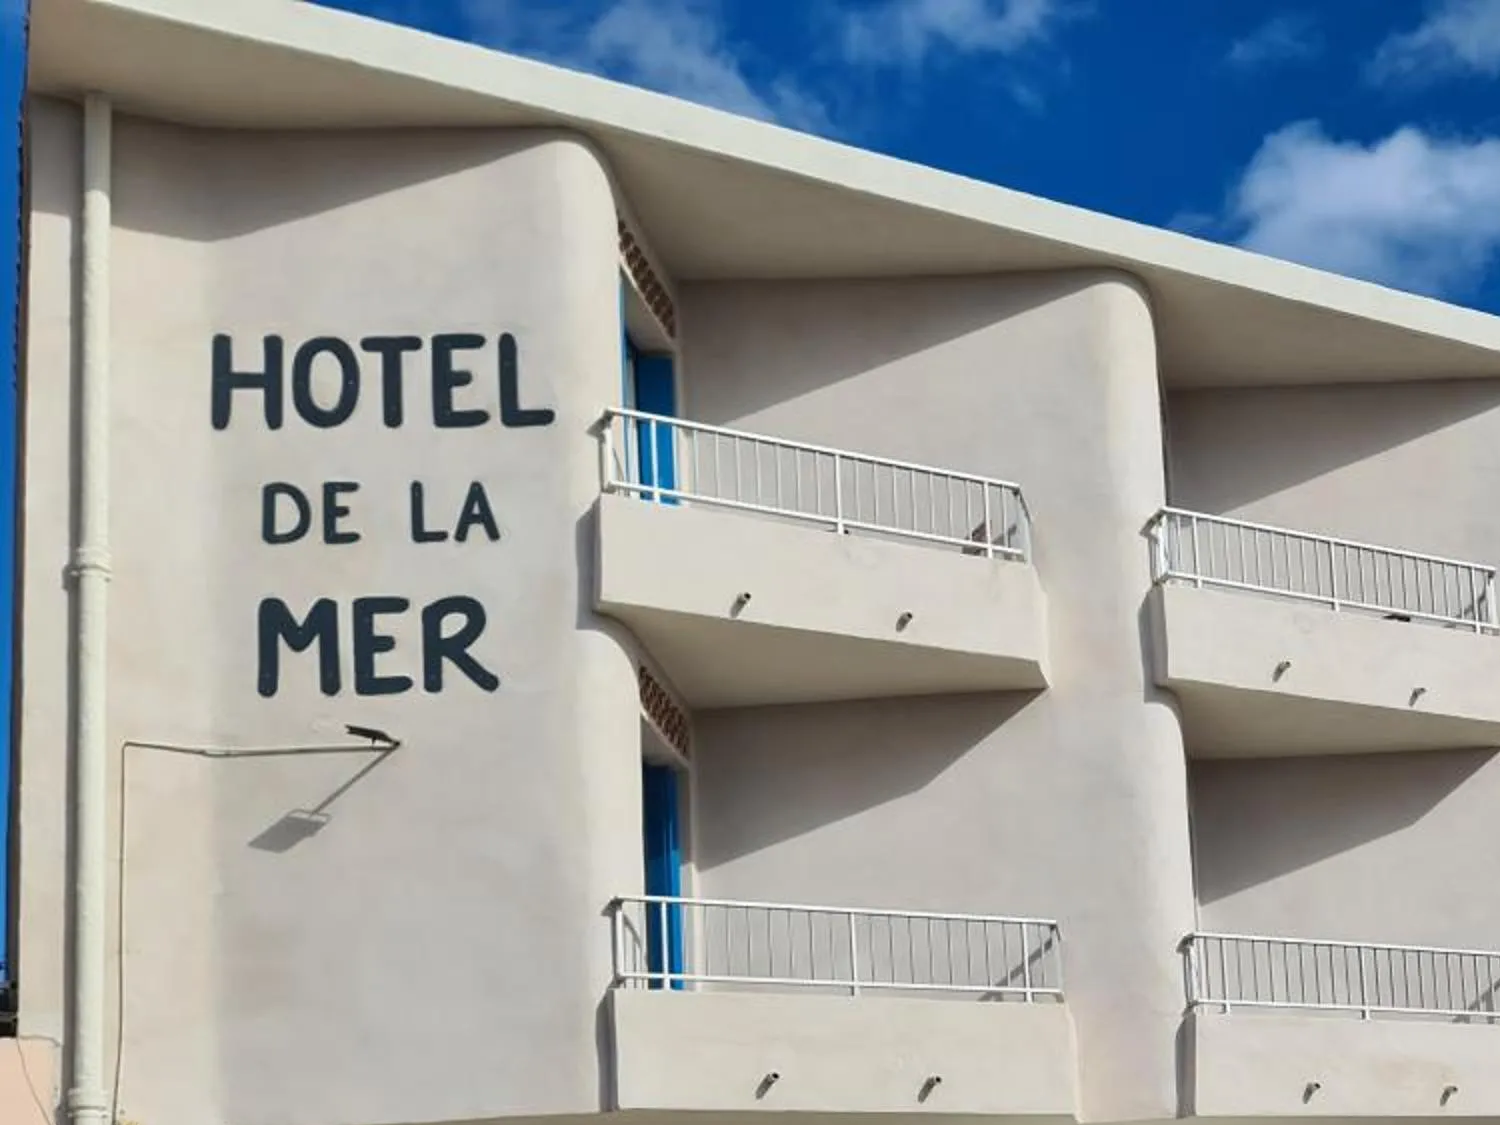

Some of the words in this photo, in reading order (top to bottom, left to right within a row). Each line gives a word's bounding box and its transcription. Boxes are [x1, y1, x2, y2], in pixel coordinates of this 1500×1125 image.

[211, 332, 555, 431] HOTEL
[261, 481, 361, 545] DE
[410, 480, 501, 543] LA
[257, 595, 500, 698] MER
